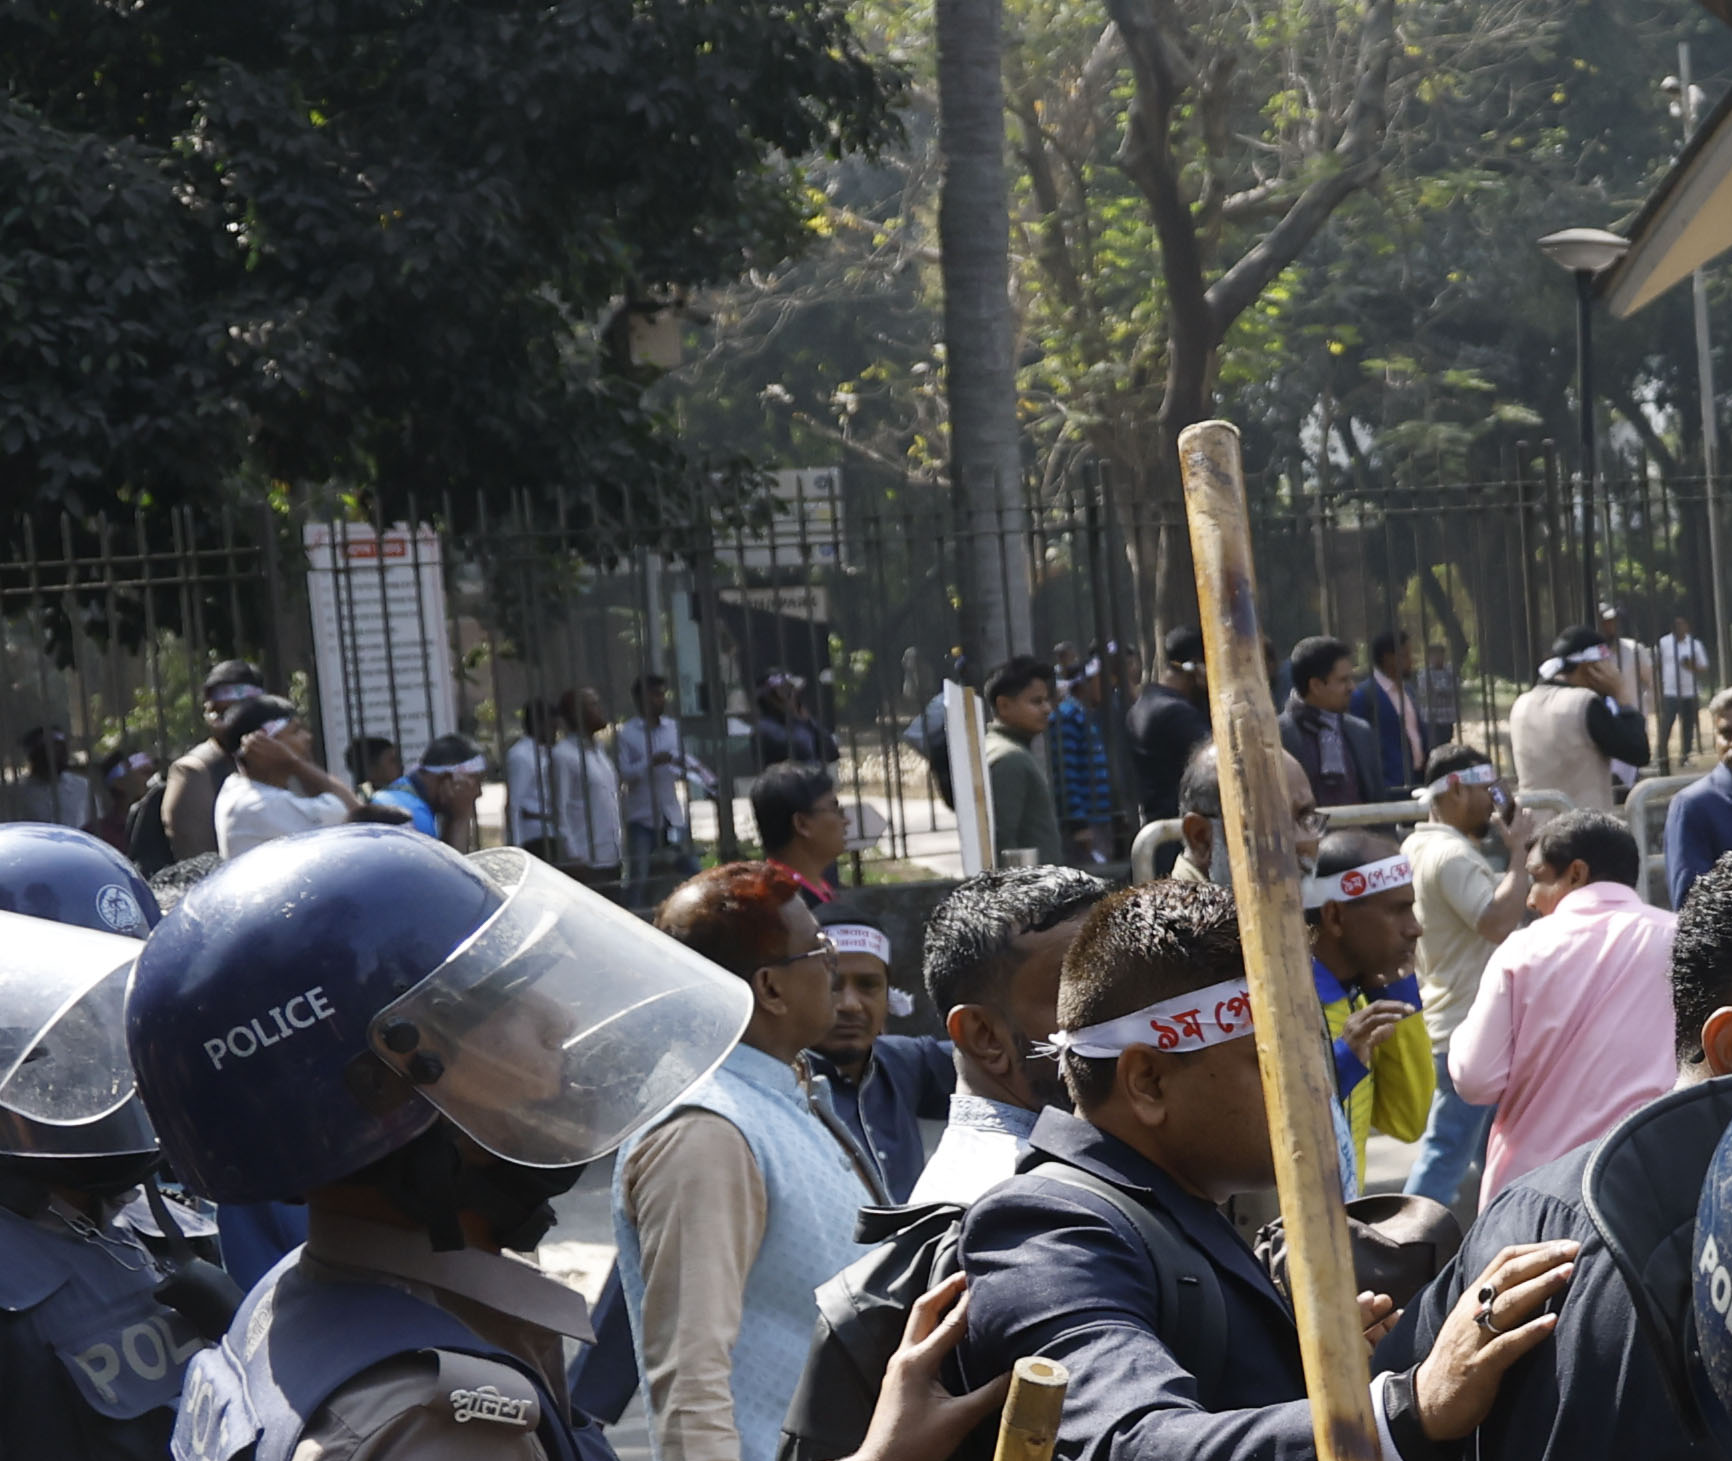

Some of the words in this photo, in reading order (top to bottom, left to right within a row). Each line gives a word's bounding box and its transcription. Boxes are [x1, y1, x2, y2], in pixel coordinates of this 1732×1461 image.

[203, 986, 336, 1070] POLICE
[1151, 1008, 1206, 1050] ৯ম
[74, 1316, 208, 1404] POL
[450, 1385, 534, 1426] পুলিশ
